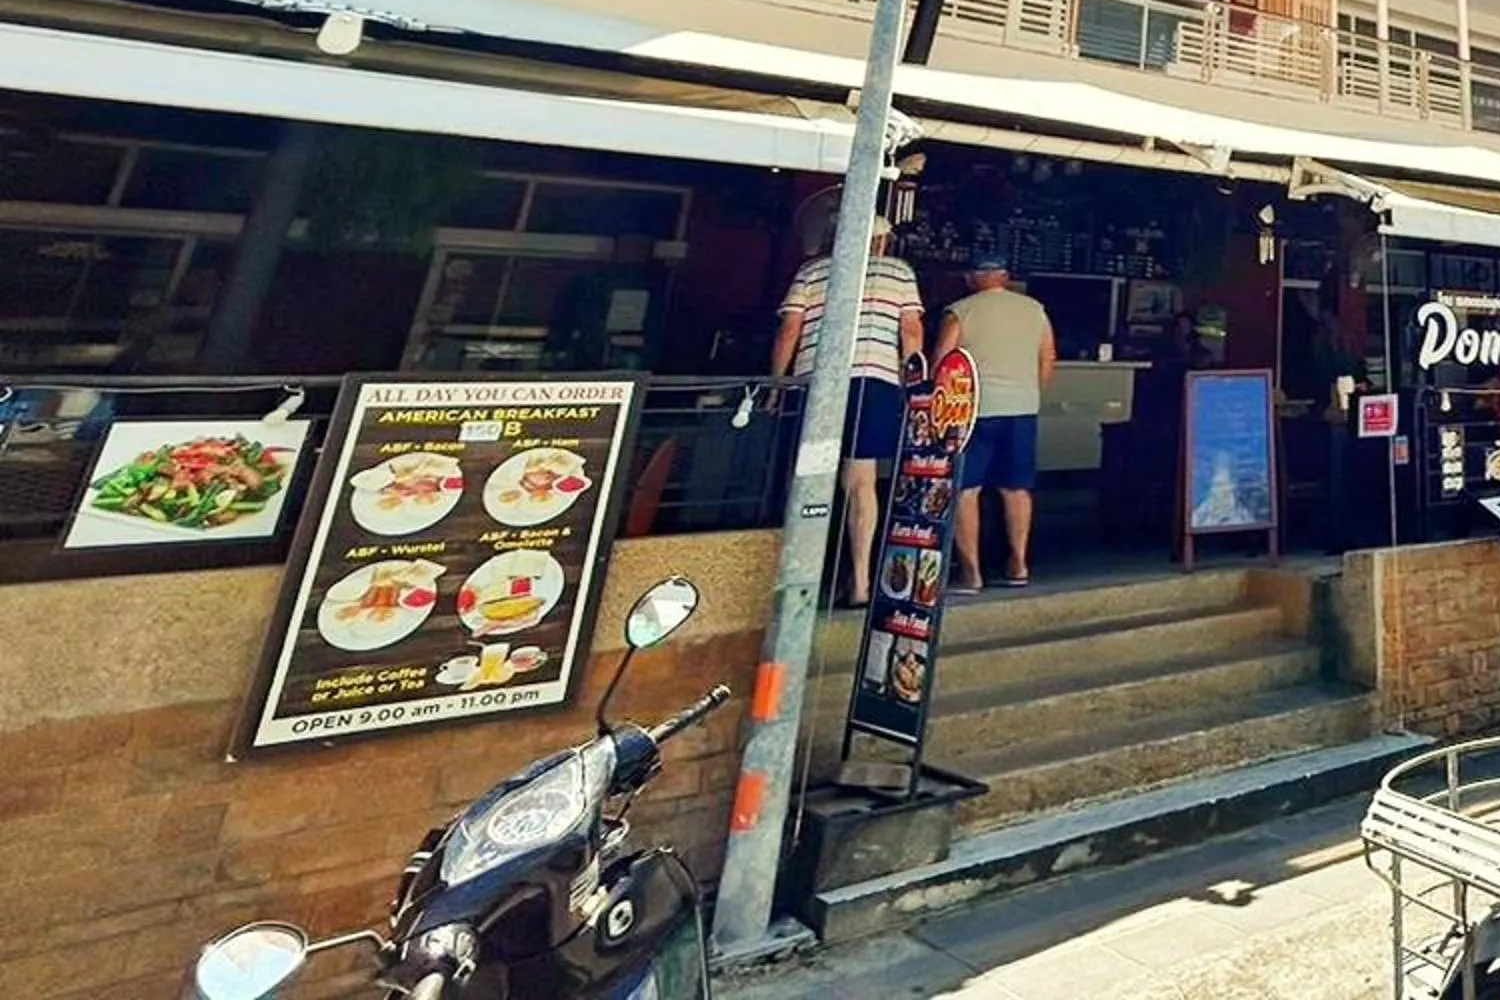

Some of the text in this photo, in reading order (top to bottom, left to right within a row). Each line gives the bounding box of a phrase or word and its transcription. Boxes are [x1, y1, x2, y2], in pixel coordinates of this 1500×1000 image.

[367, 387, 625, 402] ALL DAY YOU CAN ORDER
[378, 407, 601, 424] AMERICAN BREAKFAST
[316, 667, 427, 690] Include Coffee
[291, 712, 353, 735] OPEN
[358, 706, 406, 725] 9.00
[411, 704, 441, 718] am
[459, 692, 507, 709] 11.00
[511, 690, 541, 706] pm
